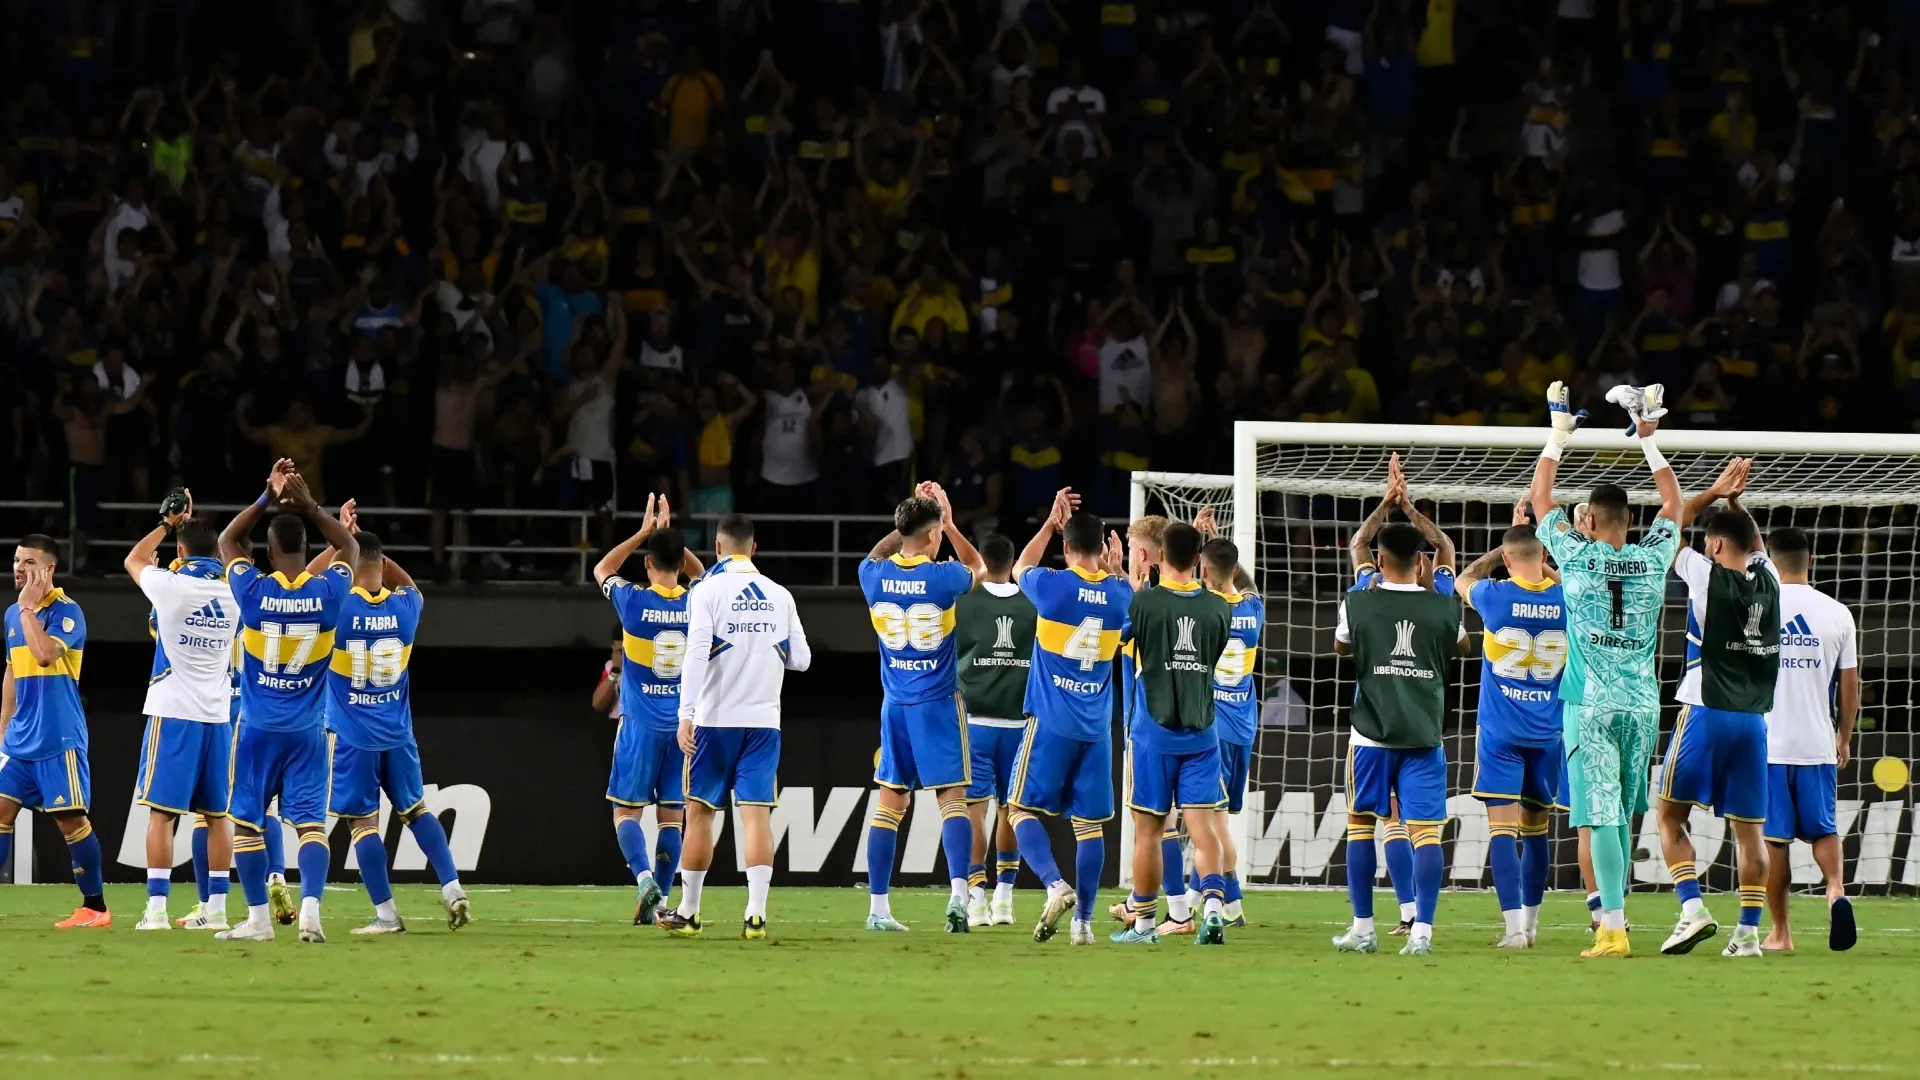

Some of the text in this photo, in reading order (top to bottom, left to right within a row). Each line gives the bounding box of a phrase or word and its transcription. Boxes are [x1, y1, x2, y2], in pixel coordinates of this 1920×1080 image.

[1604, 560, 1647, 574] ROMERO
[881, 579, 927, 595] VAZQUEZ
[260, 595, 323, 613] ADVINCULA
[1077, 587, 1108, 605] FIGAL
[1605, 577, 1625, 631] 1
[731, 599, 775, 612] adidas
[1512, 602, 1561, 619] BRIASCO
[184, 616, 231, 629] adidas
[352, 614, 399, 631] F. FABRA
[641, 608, 690, 624] FERNAND
[1230, 616, 1257, 630] DETTO
[727, 622, 777, 634] DIRECTV
[872, 601, 944, 652] 38
[178, 633, 230, 649] DIRECTV
[260, 621, 321, 675] 17
[1062, 616, 1104, 672] 4
[1590, 633, 1645, 650] DIRECTV
[1780, 633, 1820, 647] didas
[652, 630, 688, 679] 8
[1492, 626, 1568, 681] 29
[345, 637, 405, 690] 18
[889, 656, 938, 671] DIRECTV
[973, 657, 1031, 668] LIBERTADORES
[1373, 665, 1434, 679] LIBERTADORES
[257, 672, 314, 690] DIRECTV
[348, 690, 401, 705] DIRECTV
[1213, 690, 1248, 702] IRECTV
[1500, 684, 1552, 702] DIRECTV
